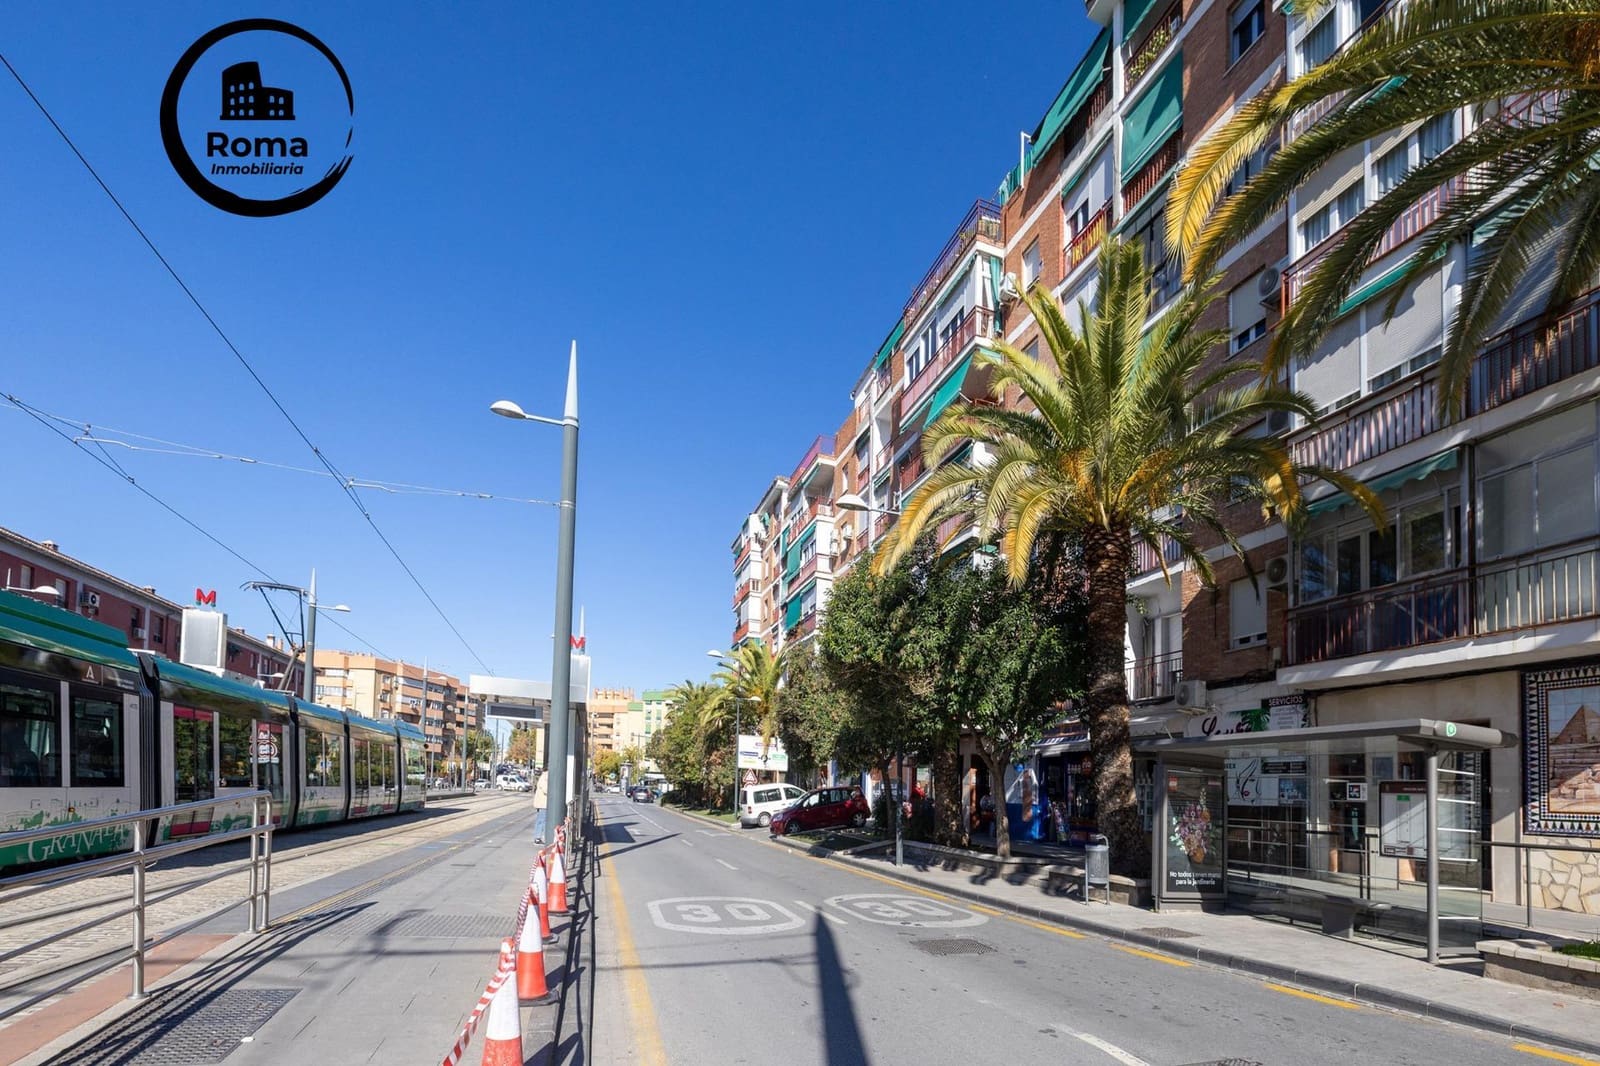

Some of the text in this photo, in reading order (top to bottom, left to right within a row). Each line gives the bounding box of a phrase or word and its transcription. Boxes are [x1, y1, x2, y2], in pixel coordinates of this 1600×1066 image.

[196, 588, 216, 607] M
[1268, 695, 1303, 706] SERVICIOS
[676, 904, 773, 923] 30
[852, 899, 953, 918] 30
